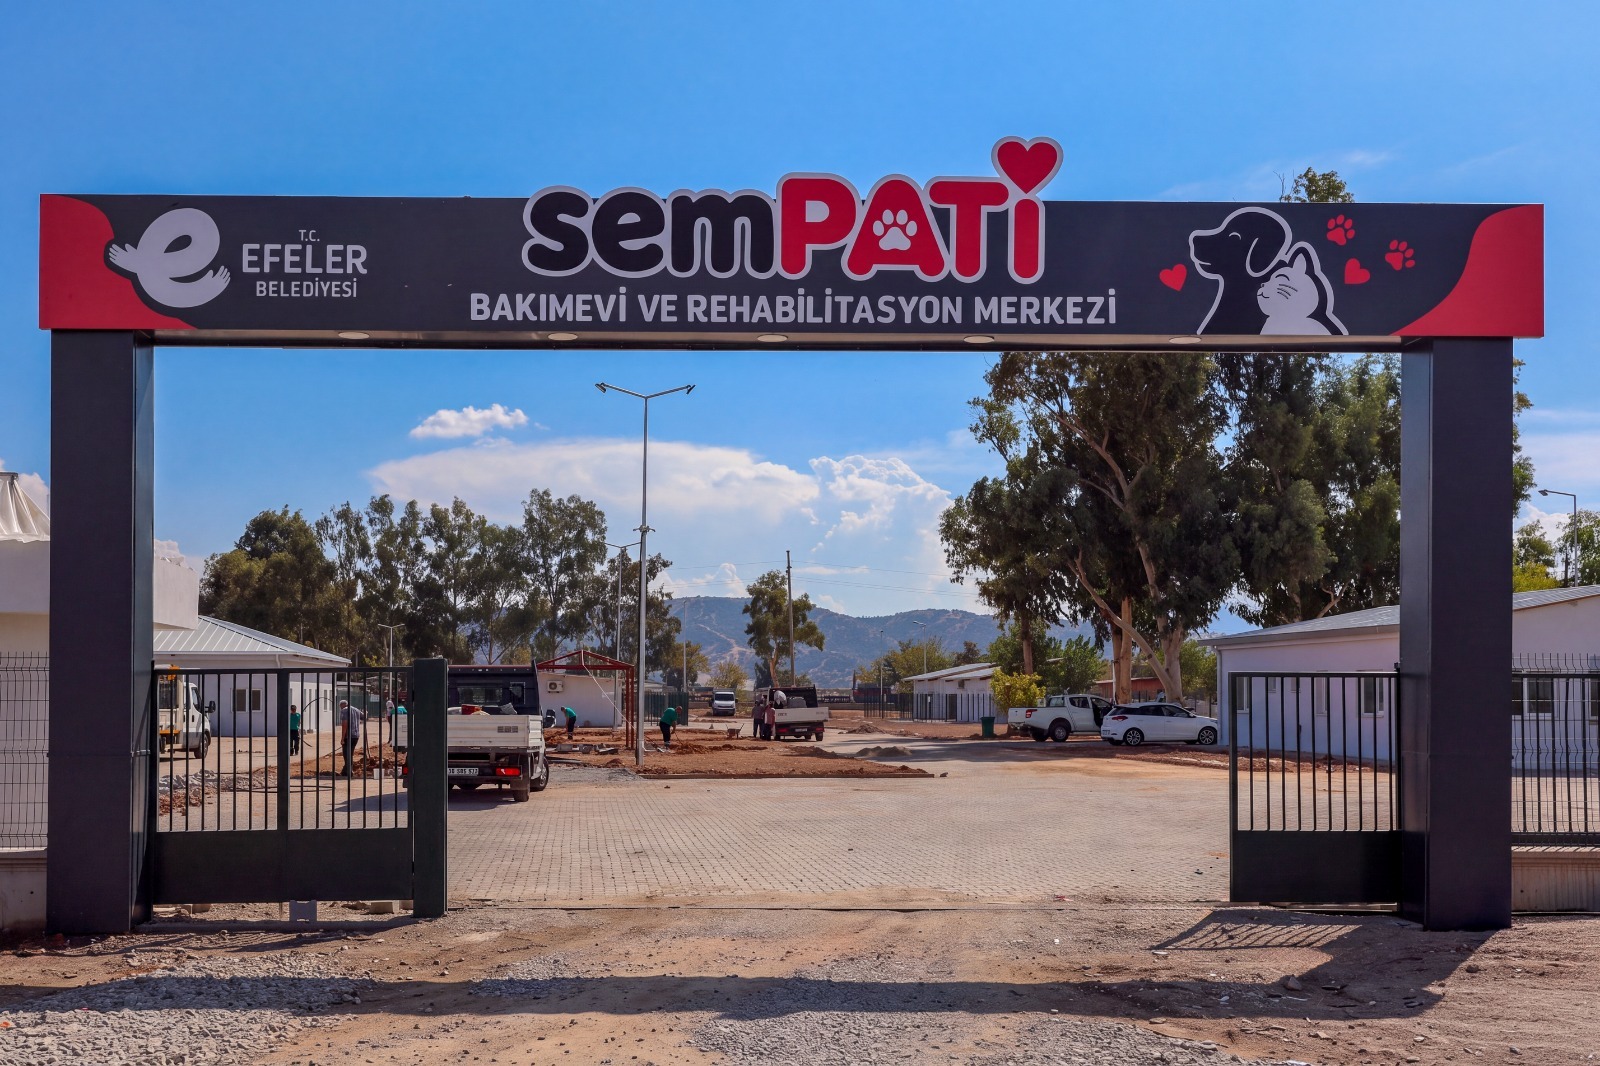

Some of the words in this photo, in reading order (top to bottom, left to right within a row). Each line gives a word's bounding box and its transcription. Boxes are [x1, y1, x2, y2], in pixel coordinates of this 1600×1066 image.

[299, 230, 320, 241] T.C.
[242, 243, 368, 274] EFELER
[256, 277, 357, 298] BELEDİYESİ
[470, 286, 627, 322] BAKIMEVİ
[638, 294, 678, 322] VE
[687, 288, 962, 323] REHABİLİTASYON
[974, 288, 1116, 324] MERKEZİ
